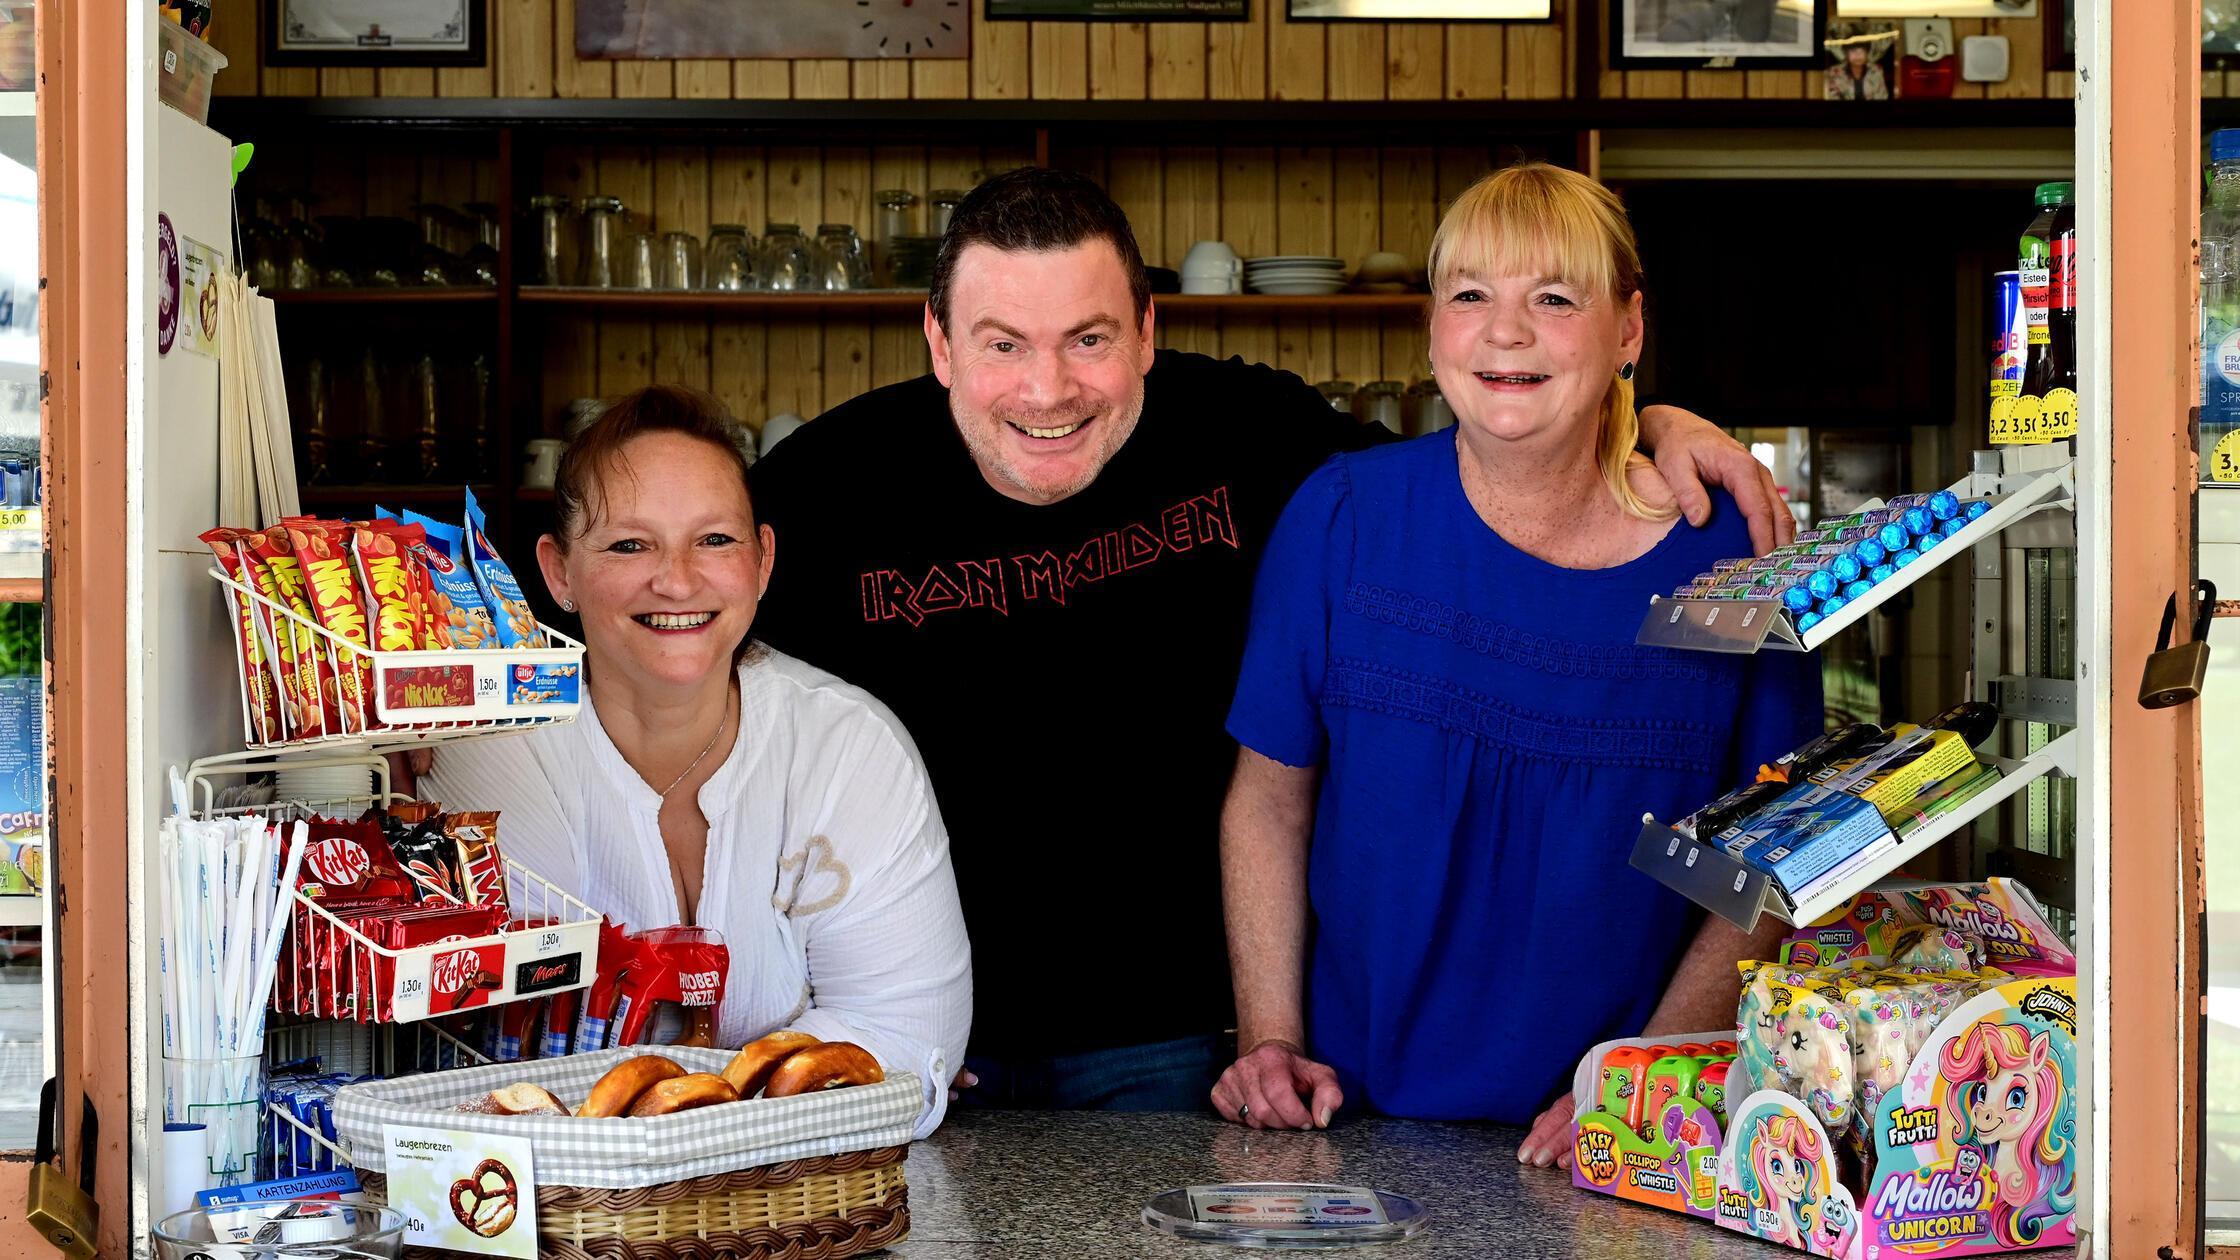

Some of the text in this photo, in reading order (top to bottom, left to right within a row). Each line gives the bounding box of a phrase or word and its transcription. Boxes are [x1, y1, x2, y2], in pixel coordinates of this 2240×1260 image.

[2023, 273, 2047, 283] Eistee
[2029, 312, 2047, 321] oder
[2224, 355, 2240, 363] FRA
[2224, 363, 2240, 371] BRU
[2220, 392, 2240, 403] SPR
[1991, 419, 2007, 434] 3,2
[2041, 411, 2069, 429] 3,50
[2220, 453, 2239, 473] 3,
[861, 486, 1239, 627] IRON MAIDEN
[535, 676, 558, 686] Erdnüsse
[313, 839, 367, 885] KitKat
[1930, 907, 2019, 940] Mallow
[1819, 932, 1852, 943] WHISTLE
[437, 951, 478, 992] KitKat
[532, 963, 567, 984] Mars
[681, 989, 717, 1006] BREZEL
[2030, 993, 2070, 1014] JOHNY
[394, 1137, 453, 1153] Laugenbrezen
[1588, 1132, 1613, 1150] KEY
[1591, 1148, 1611, 1160] CAR
[1623, 1152, 1661, 1170] LOLLIPOP
[1591, 1160, 1615, 1179] POP
[257, 1176, 346, 1199] KARTENZAHLUNG
[1629, 1168, 1676, 1190] & WHISTLE
[1874, 1173, 1982, 1217] Mallow
[233, 1231, 250, 1240] VISA
[1888, 1215, 1977, 1240] UNICORN
